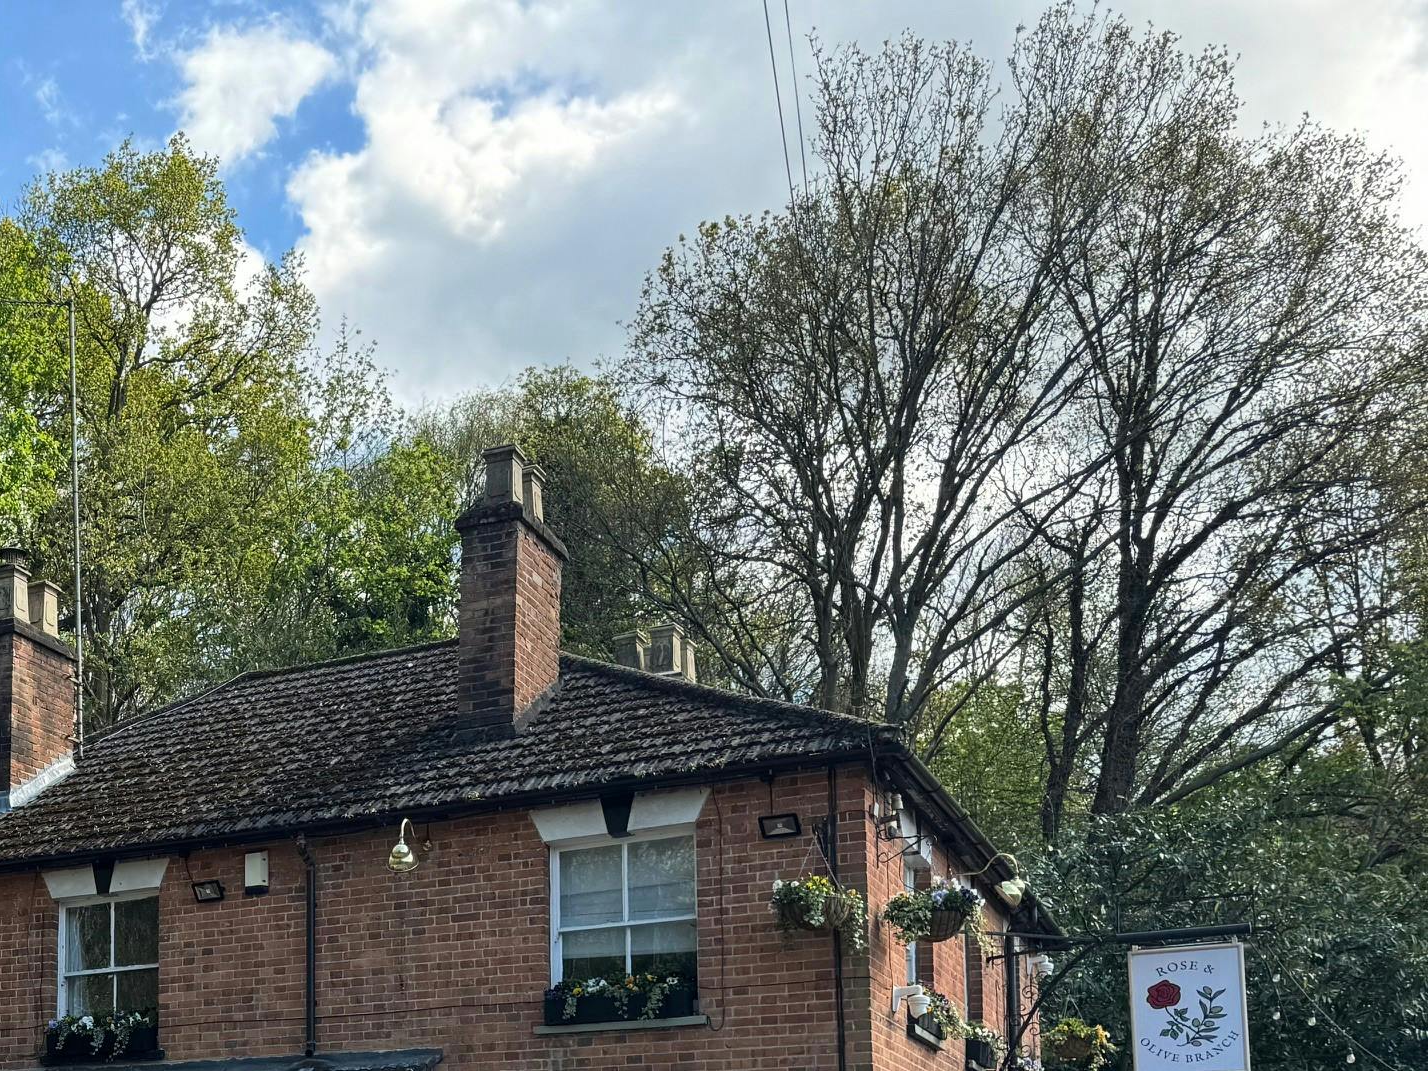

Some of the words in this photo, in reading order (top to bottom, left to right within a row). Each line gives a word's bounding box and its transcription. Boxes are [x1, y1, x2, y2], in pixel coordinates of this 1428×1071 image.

[1155, 960, 1199, 977] ROSE
[1203, 964, 1215, 974] &
[1140, 1037, 1180, 1062] OLIVE
[1186, 1029, 1240, 1063] BRANCH
